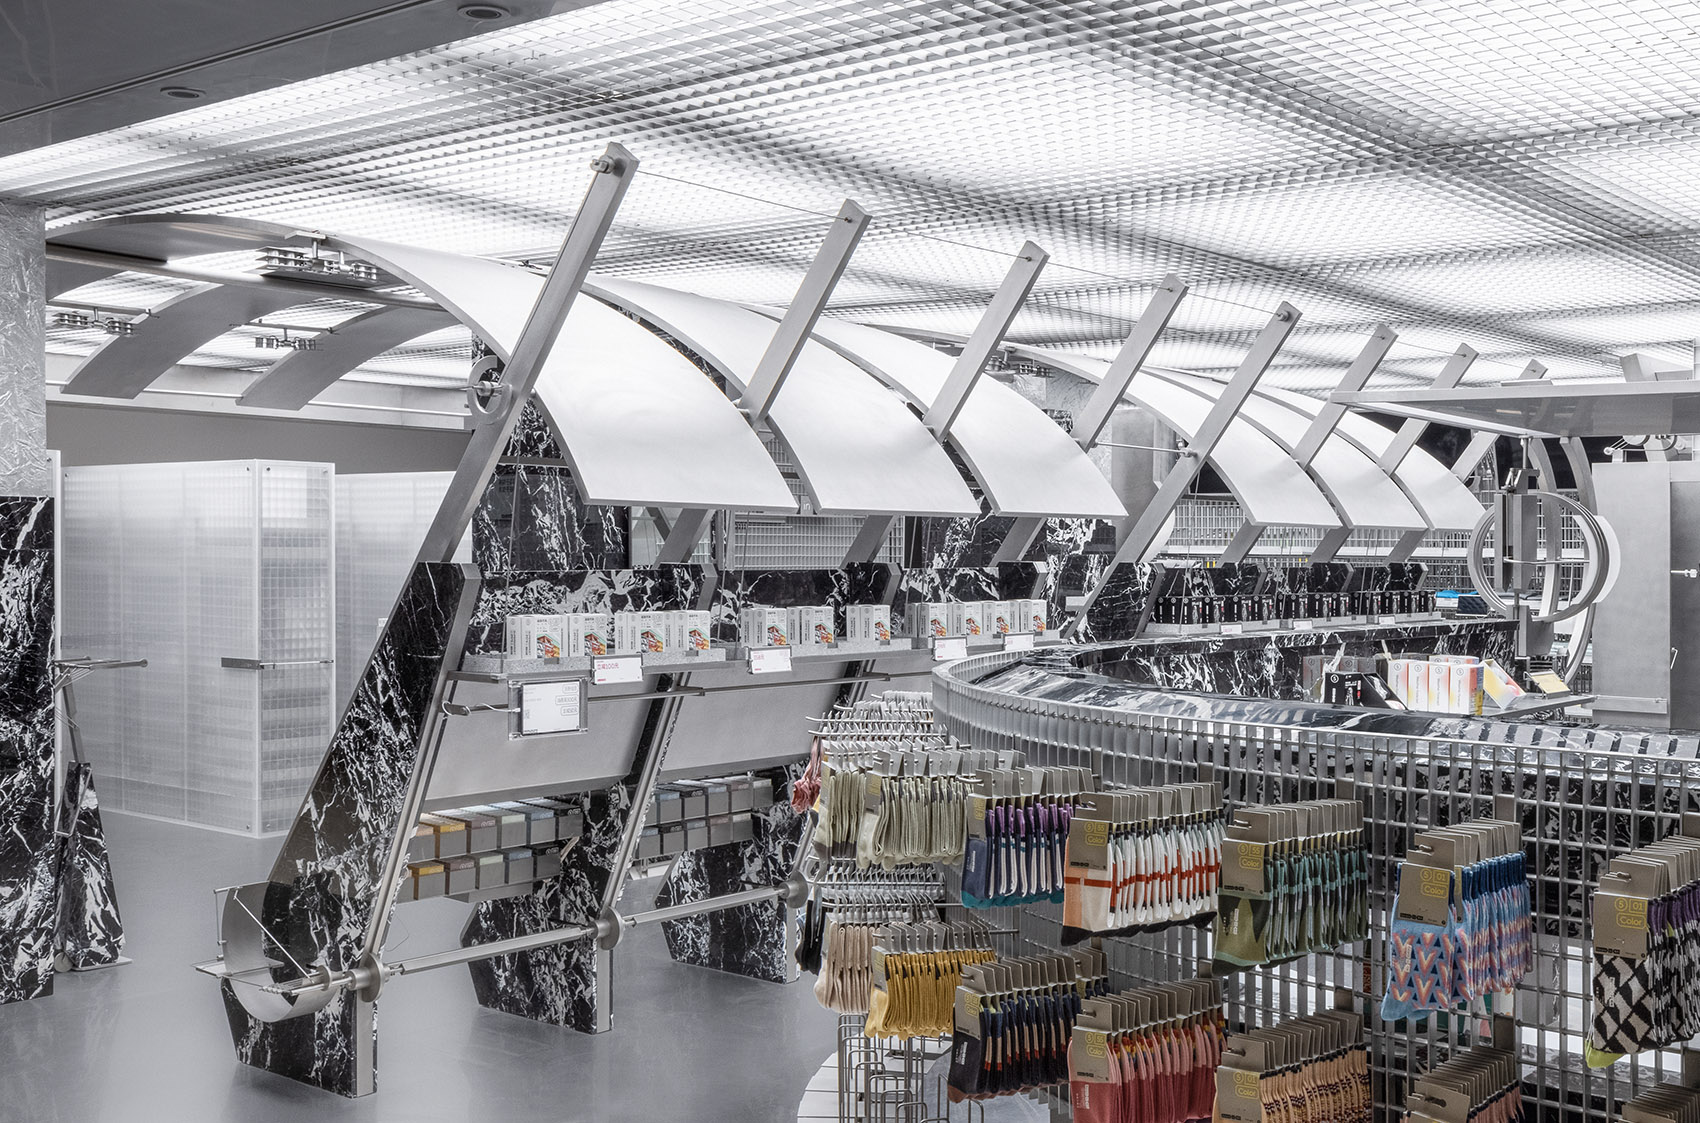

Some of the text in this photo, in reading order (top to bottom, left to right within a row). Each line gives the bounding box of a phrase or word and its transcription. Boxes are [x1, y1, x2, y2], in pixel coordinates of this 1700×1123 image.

[1242, 859, 1259, 867] Color
[1437, 872, 1446, 881] 01
[1424, 886, 1445, 895] Color
[1632, 902, 1643, 911] 01
[1620, 916, 1642, 926] Color
[1089, 1047, 1104, 1055] Color
[1238, 1088, 1256, 1097] Color
